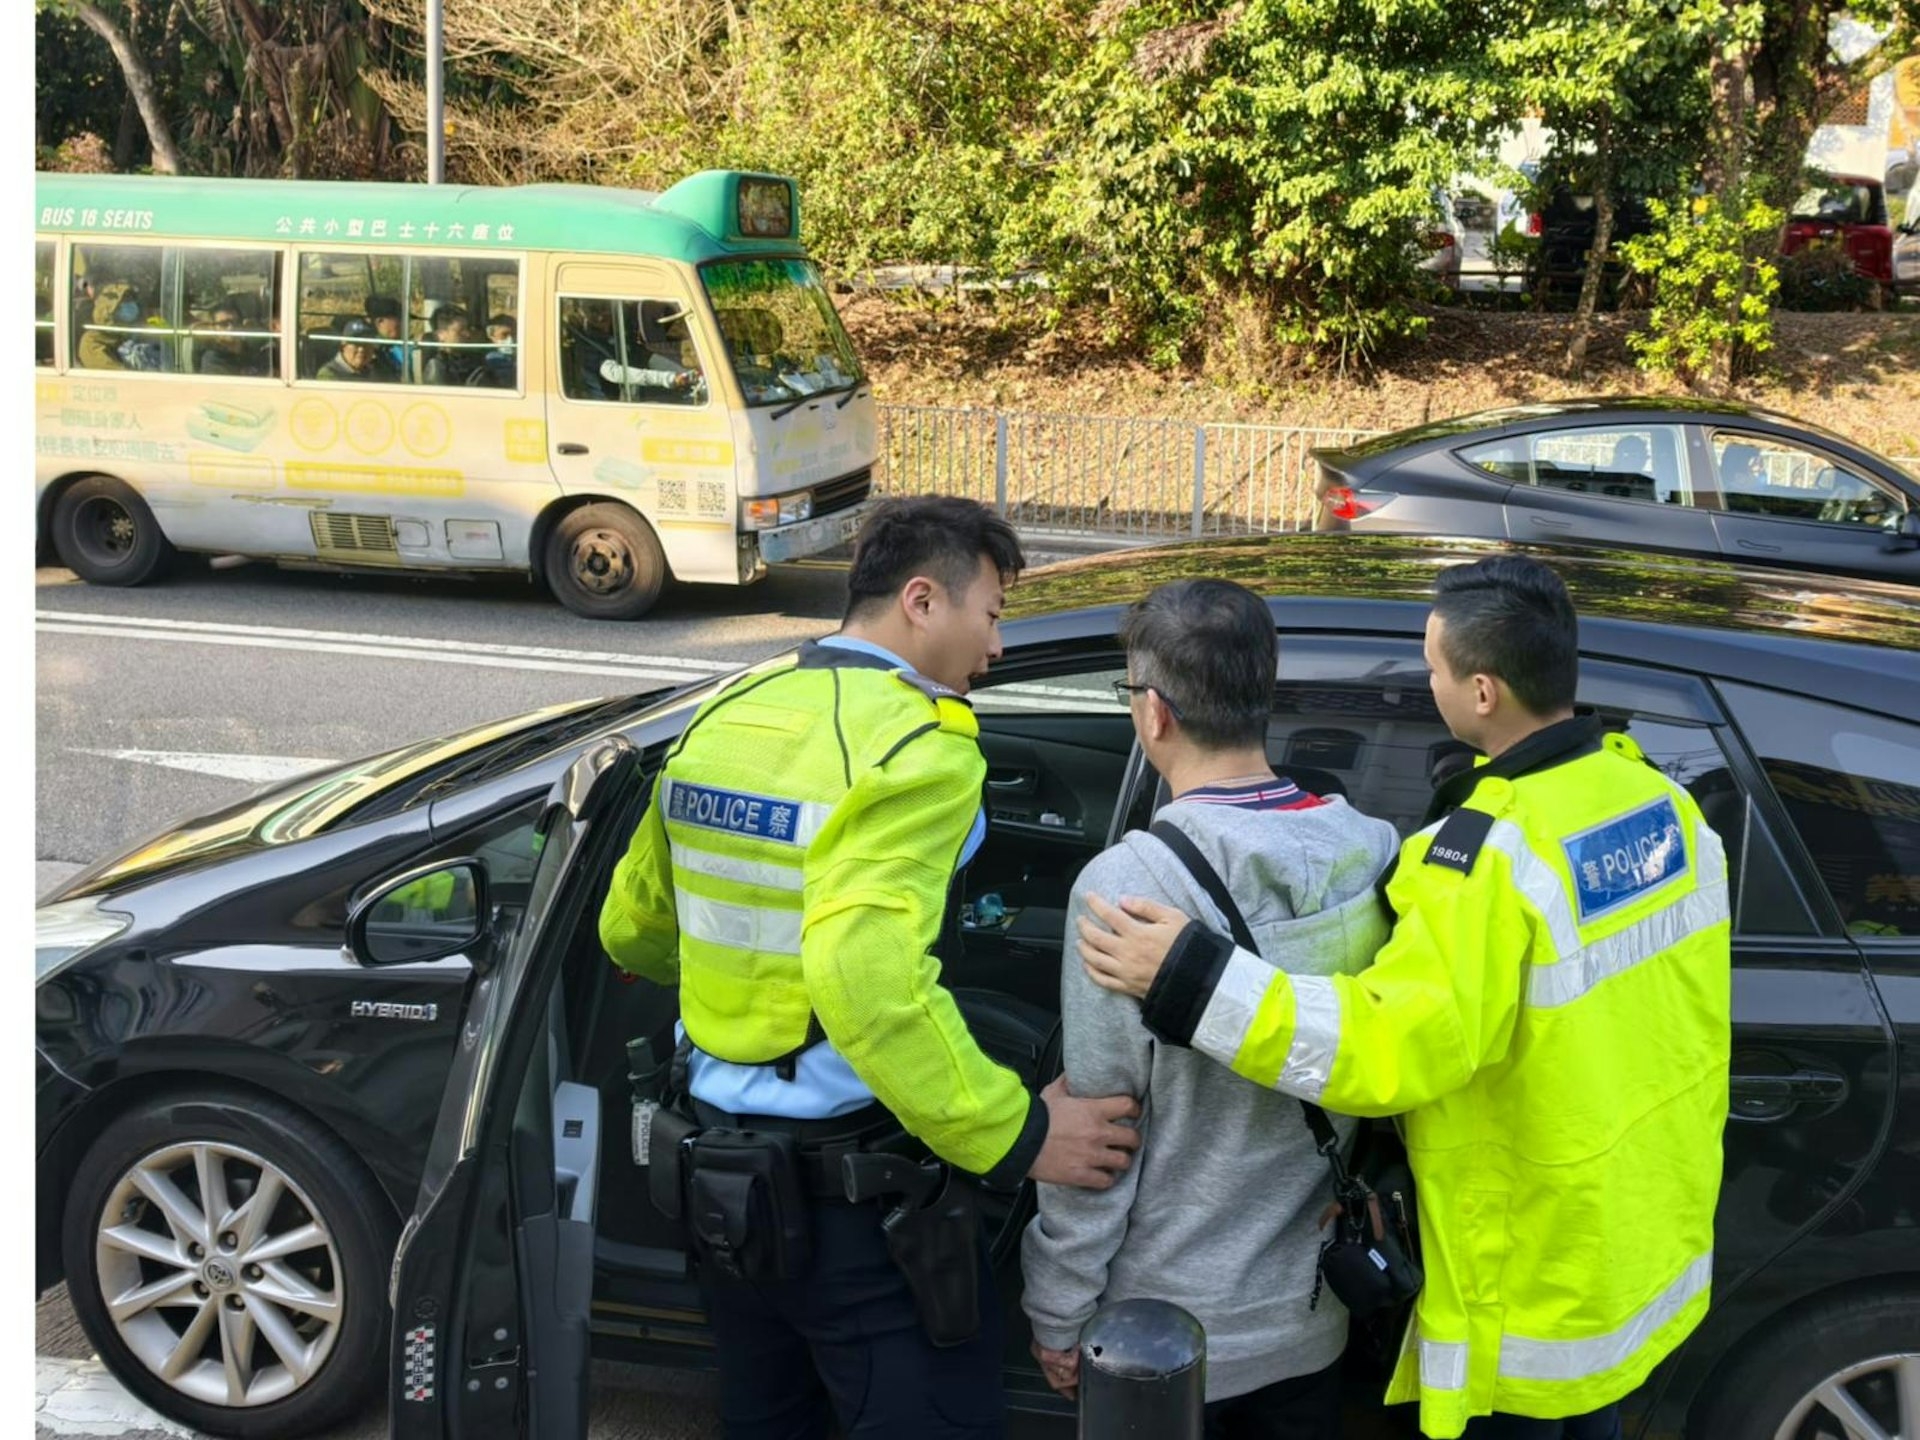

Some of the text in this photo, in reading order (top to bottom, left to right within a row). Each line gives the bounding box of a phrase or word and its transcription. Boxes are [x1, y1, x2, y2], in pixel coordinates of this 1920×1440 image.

[41, 206, 154, 230] BUS 16 SEATS
[276, 216, 515, 241] 公共小型巴士十六座位
[686, 790, 762, 832] POLICE
[768, 805, 792, 838] 察
[1432, 845, 1468, 864] 19804
[351, 1001, 424, 1020] HYBRID
[412, 1343, 424, 1387] OPEN
